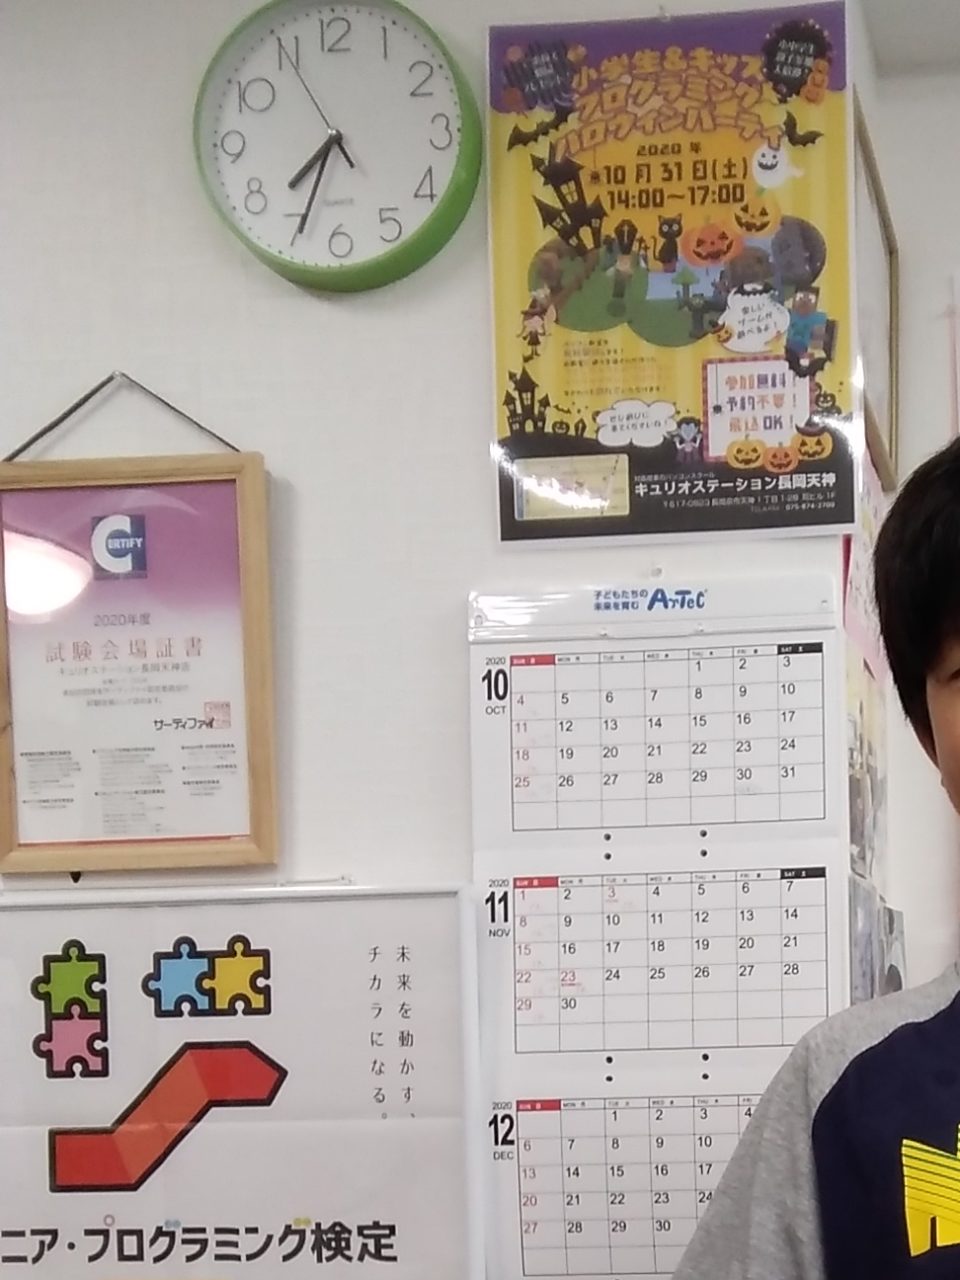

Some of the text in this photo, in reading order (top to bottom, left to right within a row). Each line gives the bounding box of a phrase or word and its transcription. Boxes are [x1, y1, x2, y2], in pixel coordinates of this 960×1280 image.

[319, 17, 351, 52] 12
[381, 26, 388, 61] 1
[409, 61, 434, 97] 2
[236, 77, 276, 114] 10
[430, 113, 453, 151] 3
[220, 130, 246, 164] 9
[637, 143, 682, 156] 2020
[603, 157, 748, 185] 10 月 31 日(土)
[244, 177, 268, 214] 8
[413, 165, 438, 203] 4
[283, 213, 306, 247] 7
[379, 207, 402, 243] 5
[328, 223, 353, 258] 6
[633, 471, 836, 498] キュリオステーション長岡天神
[594, 588, 649, 600] 子どもたちの
[594, 600, 639, 611] 未来を育む
[94, 613, 152, 627] 2020年度
[46, 636, 203, 663] 試験会場証書
[485, 657, 506, 665] 2020
[695, 655, 791, 672] 1 2 3
[482, 669, 509, 701] 10
[561, 682, 796, 705] 5 6 7 8 9 10
[485, 706, 506, 716] OCT
[558, 710, 796, 733] 12 13 14 15 16 17
[153, 717, 216, 731] サーティファイ
[559, 737, 796, 760] 19 20 21 22 23 24
[558, 765, 796, 788] 26 27 28 29 30 31
[488, 880, 510, 888] 2020
[563, 880, 794, 901] 2 4 5 6 7
[484, 890, 508, 924] 11
[563, 907, 799, 928] 9 10 11 12 13 14
[488, 929, 511, 938] NOV
[561, 935, 798, 955] 16 17 18 19 20 21
[604, 962, 800, 982] 24 25 26 27 28
[561, 997, 577, 1010] 30
[368, 945, 388, 1120] チカラになる。
[396, 944, 417, 1119] 未来を動かす、
[491, 1102, 512, 1110] 2020
[612, 1106, 753, 1122] 1 2 3 4
[488, 1113, 515, 1147] 12
[567, 1135, 713, 1151] 7 8 9 10
[493, 1151, 515, 1161] DEC
